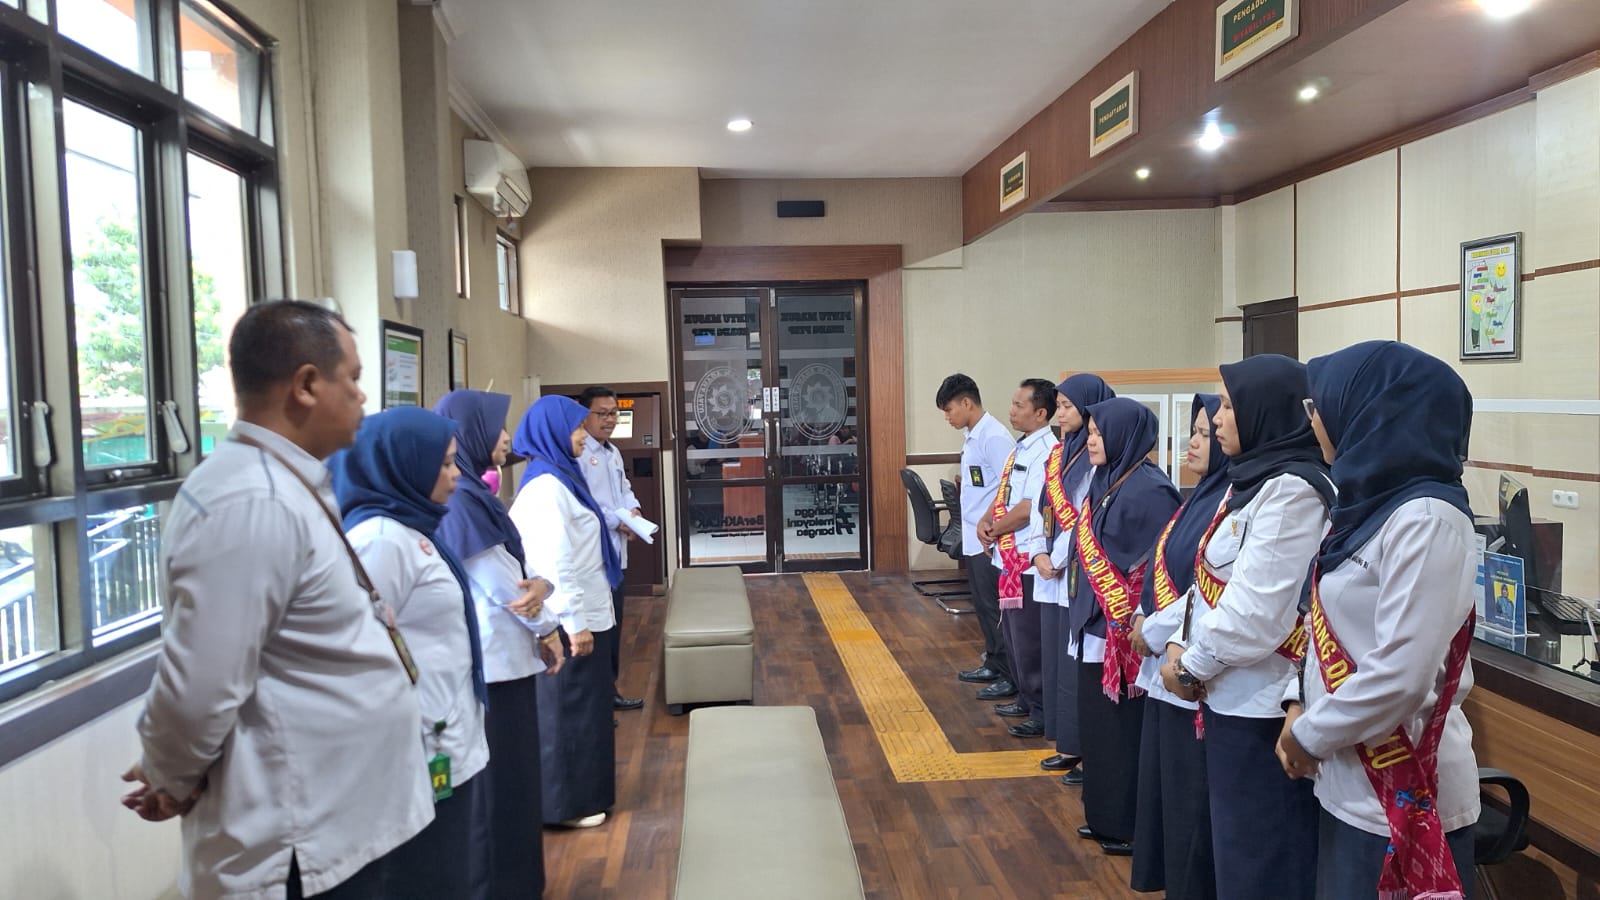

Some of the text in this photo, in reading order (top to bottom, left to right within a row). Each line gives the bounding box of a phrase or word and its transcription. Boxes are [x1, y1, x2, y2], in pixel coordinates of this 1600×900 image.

[1089, 559, 1109, 577] DI
[1095, 571, 1118, 593] PA
[1103, 586, 1133, 620] PALU
[1326, 659, 1357, 689] DI
